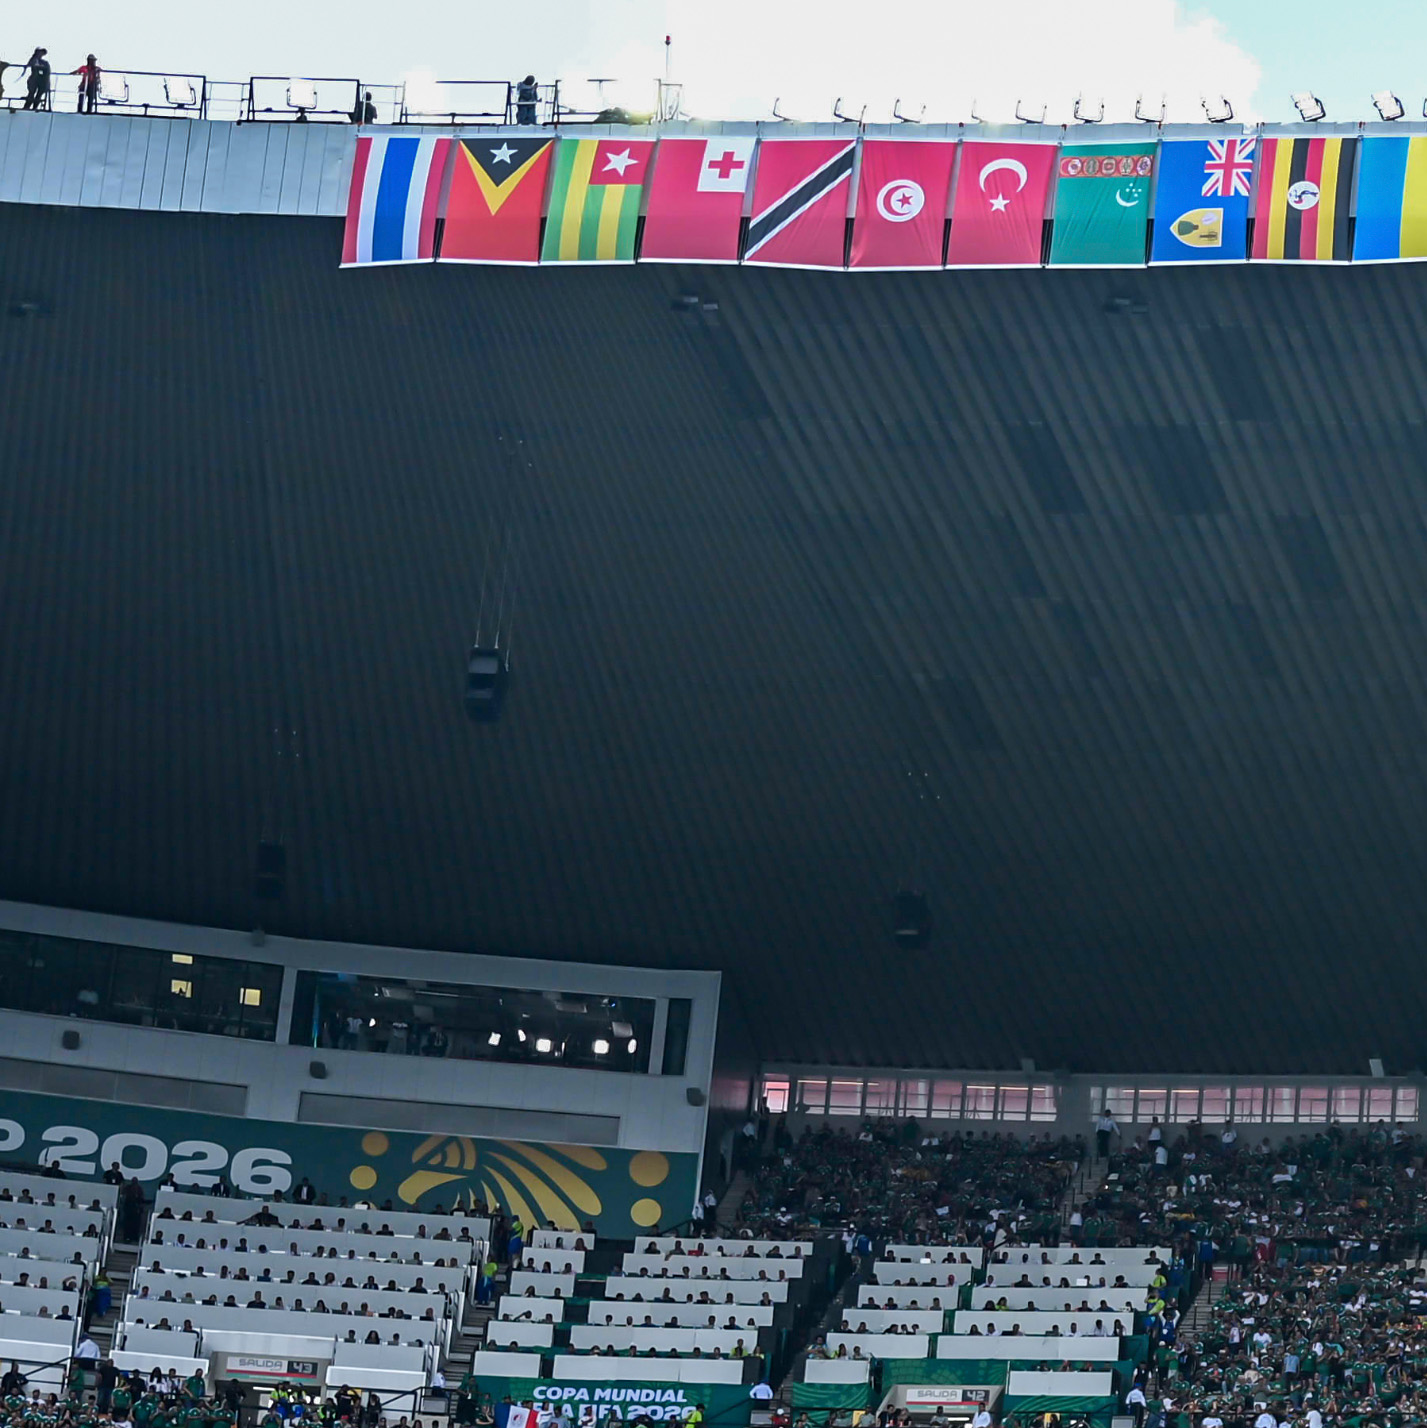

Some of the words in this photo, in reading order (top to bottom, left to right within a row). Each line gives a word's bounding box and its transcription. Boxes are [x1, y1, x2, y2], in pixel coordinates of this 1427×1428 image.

[39, 1125, 294, 1196] 2026
[292, 1361, 316, 1374] 43
[533, 1387, 590, 1401] COPA
[594, 1388, 688, 1402] MUNDIAL
[917, 1389, 961, 1399] SALIDA
[967, 1390, 986, 1401] 42
